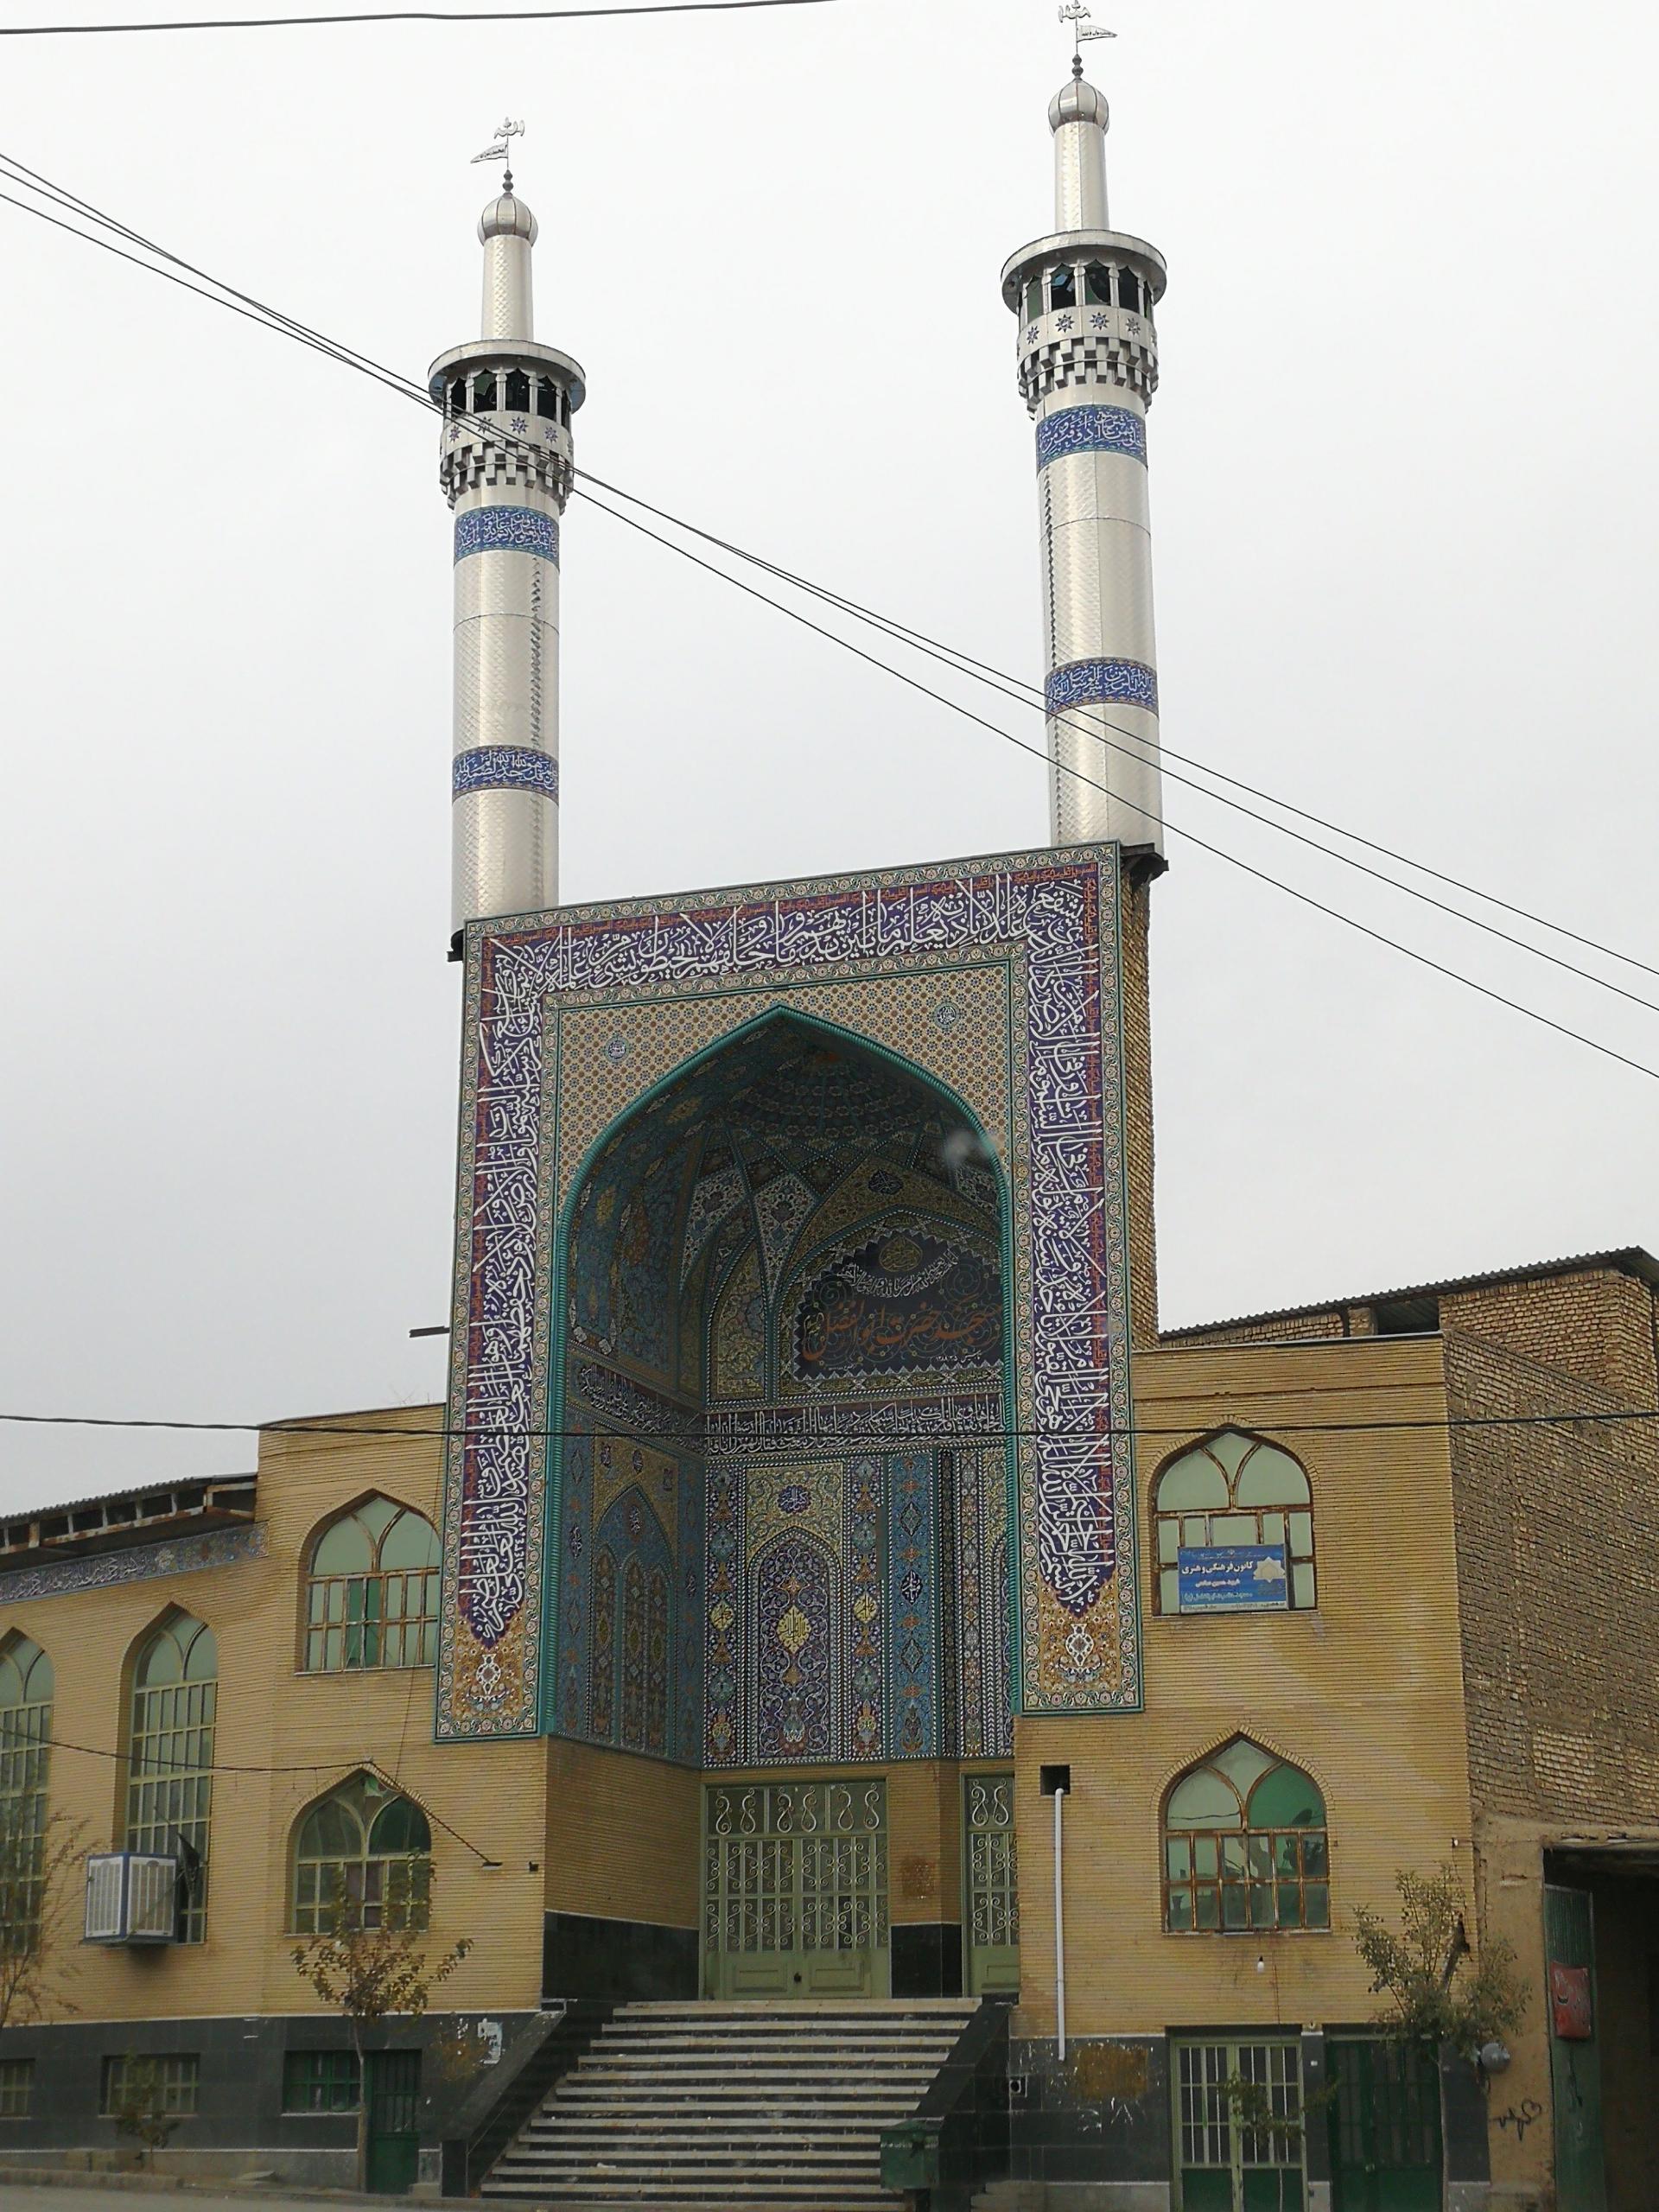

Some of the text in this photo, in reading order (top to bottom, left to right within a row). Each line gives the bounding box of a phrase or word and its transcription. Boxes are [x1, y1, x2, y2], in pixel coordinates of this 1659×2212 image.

[1181, 1560, 1254, 1574] کانون فرهنگی و هنری
